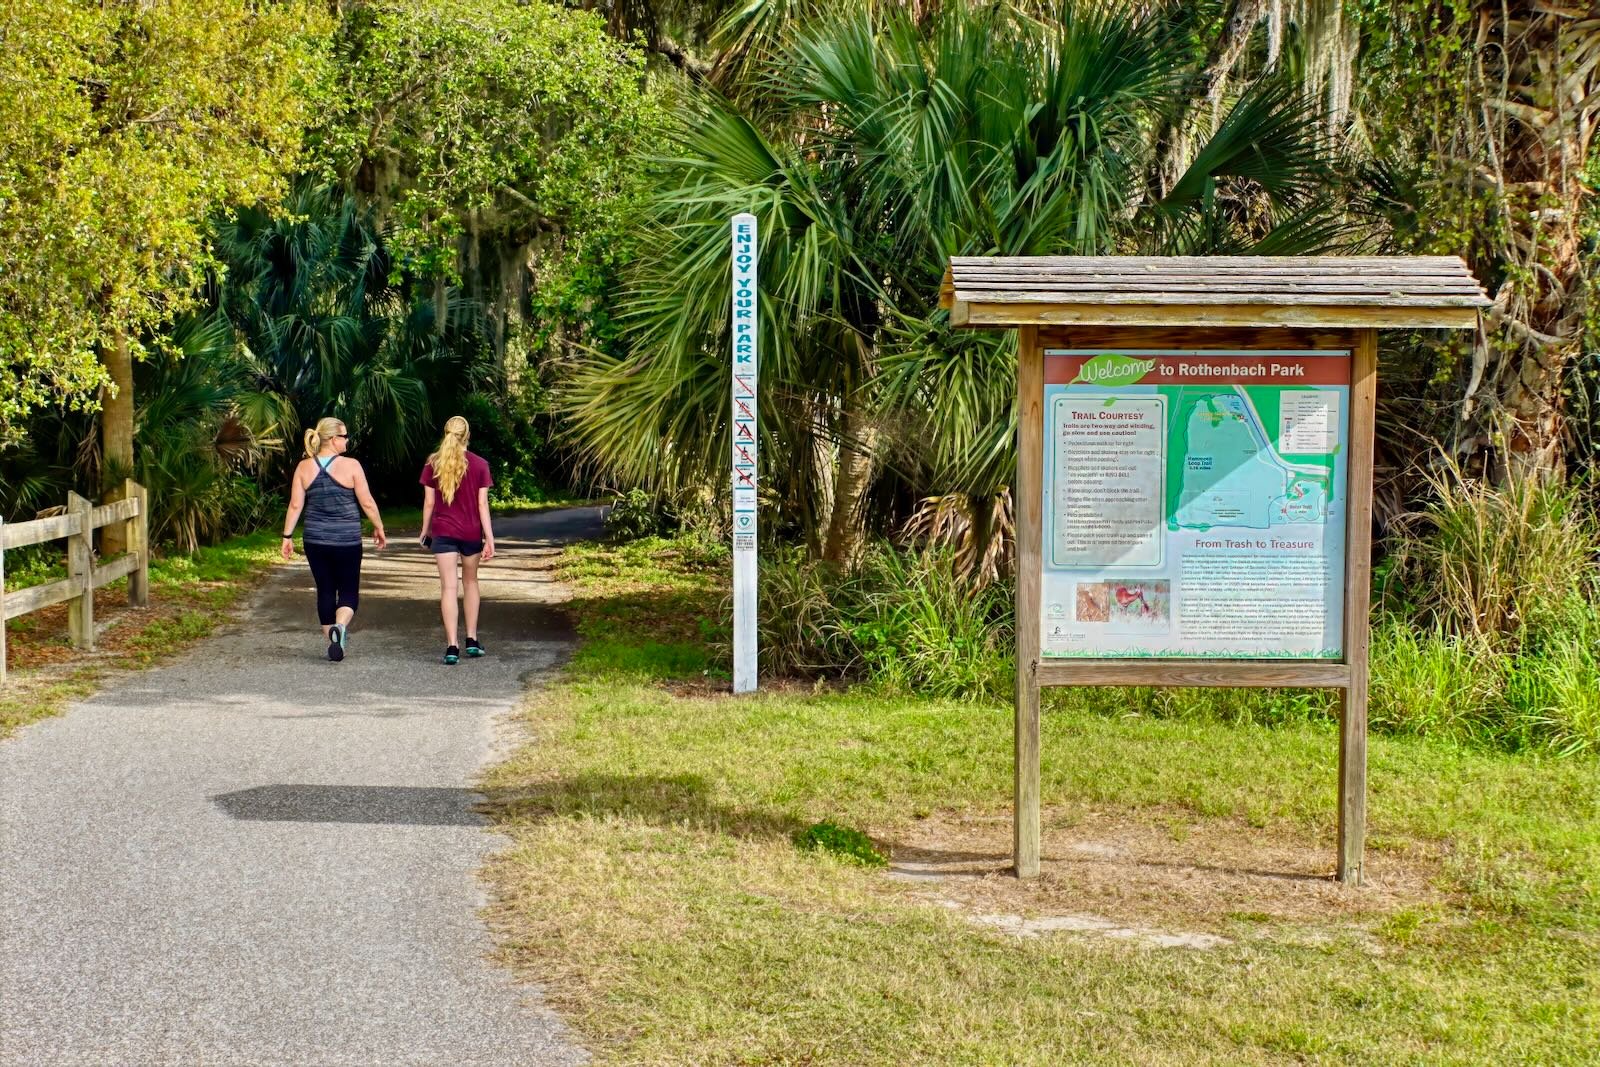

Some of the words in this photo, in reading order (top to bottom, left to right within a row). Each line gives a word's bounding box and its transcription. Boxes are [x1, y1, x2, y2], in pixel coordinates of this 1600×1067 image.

[736, 224, 752, 273] ENJOY
[736, 278, 752, 318] YOUR
[736, 324, 752, 363] PARK
[1079, 359, 1156, 382] Welcome
[1159, 363, 1174, 376] to
[1178, 363, 1266, 376] Rothenbach
[1270, 363, 1305, 376] Park
[1195, 539, 1221, 549] From
[1224, 539, 1252, 549] Trash
[1255, 540, 1267, 549] to
[1270, 539, 1314, 549] Treasure
